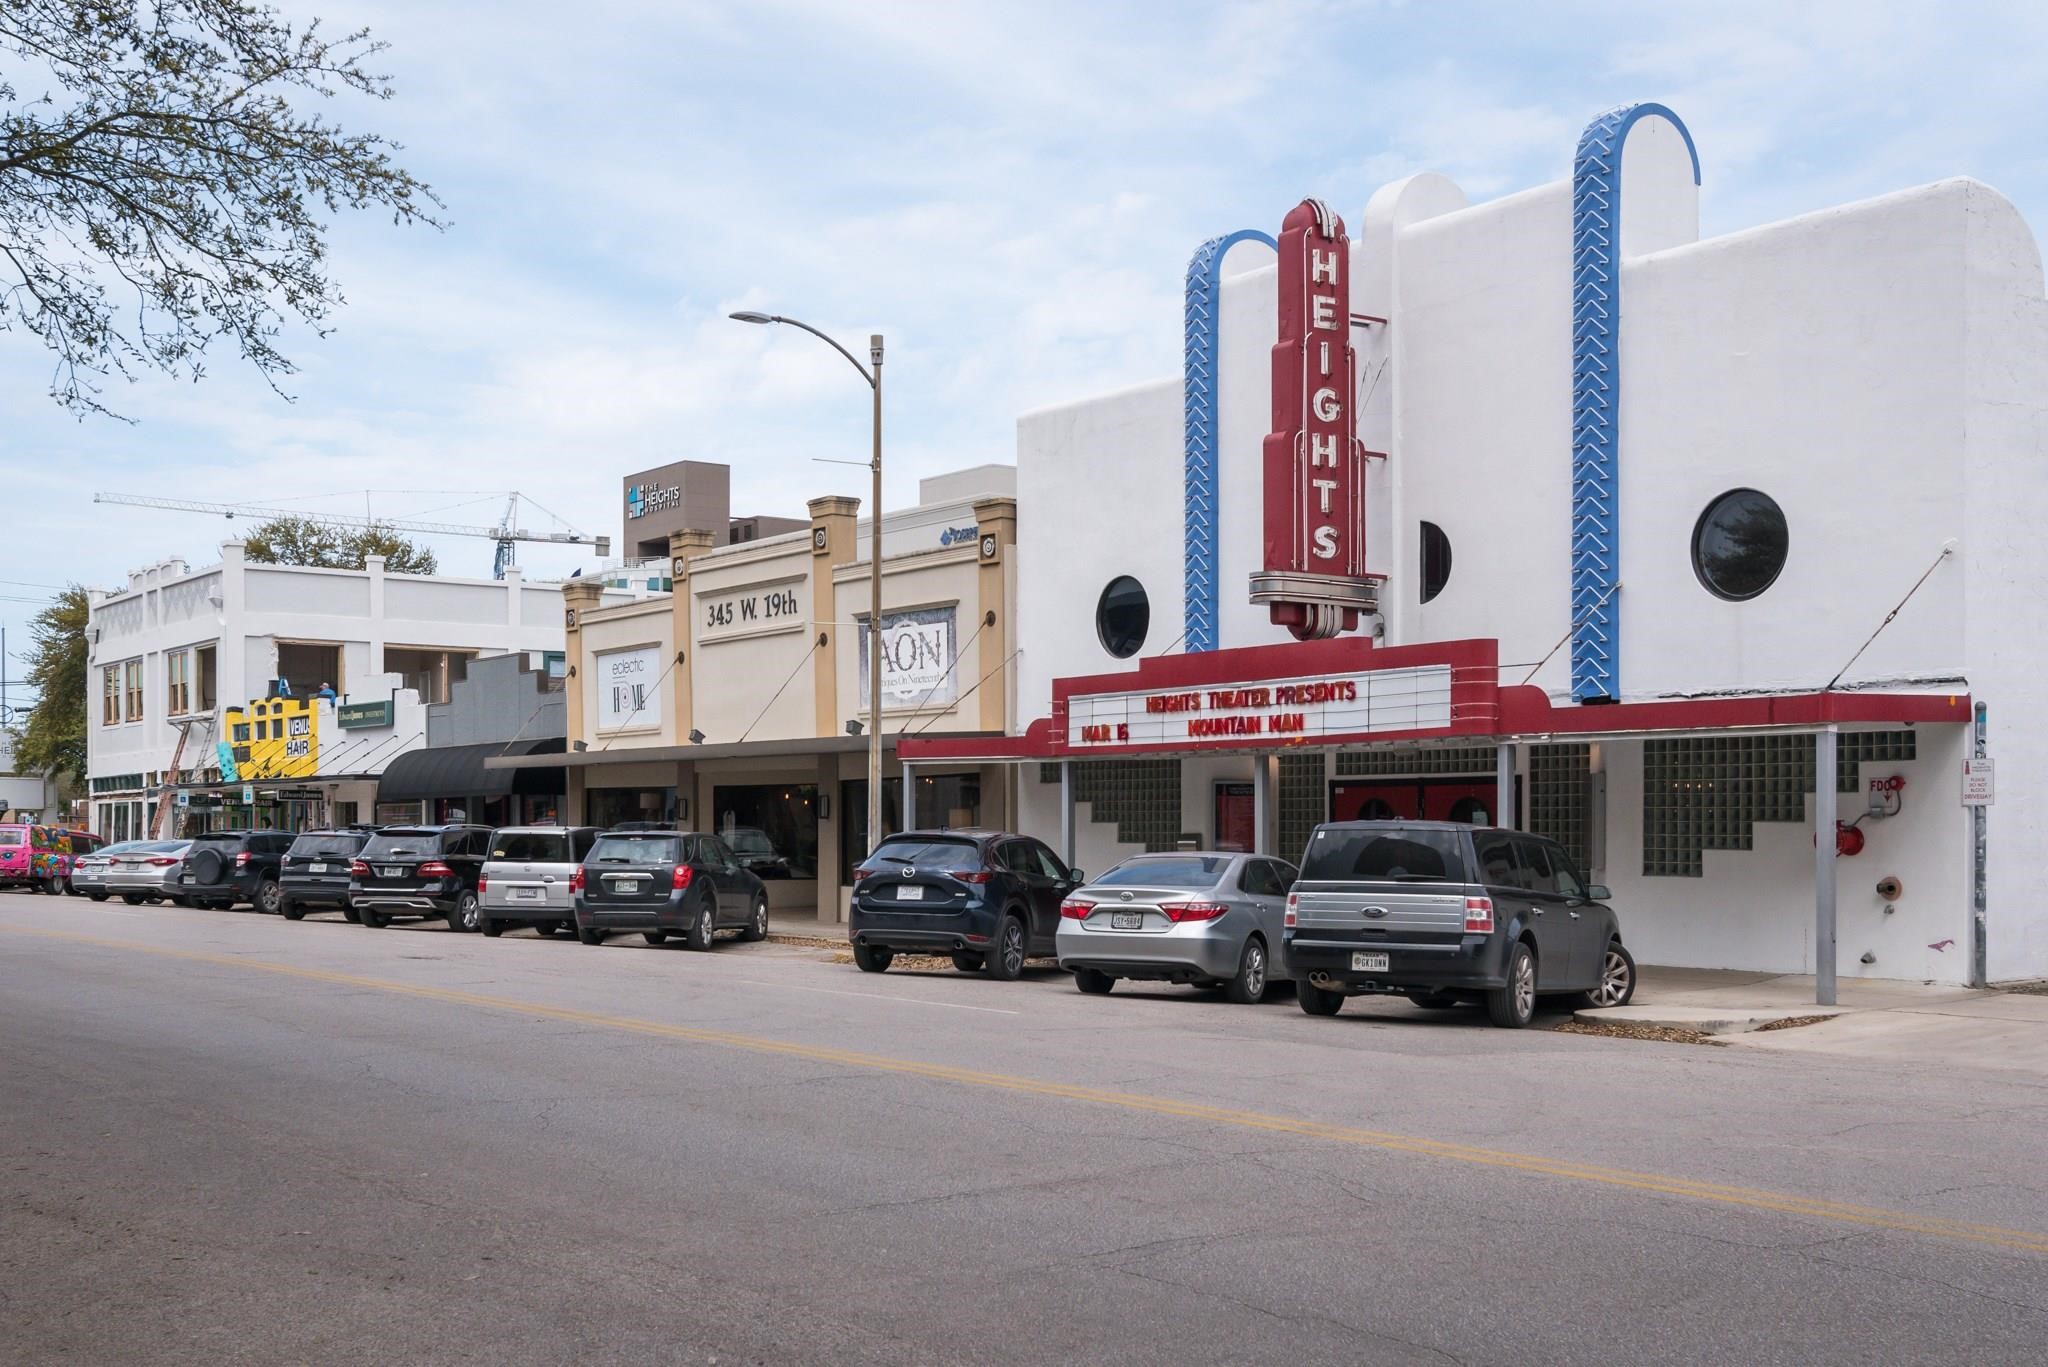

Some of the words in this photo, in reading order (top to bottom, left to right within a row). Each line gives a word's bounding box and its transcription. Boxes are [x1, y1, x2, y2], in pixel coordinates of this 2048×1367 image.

[1311, 248, 1343, 559] HEIGHTS
[645, 482, 658, 492] THE
[645, 486, 680, 506] HEIGHTS
[645, 500, 680, 513] HOSPITAL
[707, 602, 733, 627] 345
[740, 597, 758, 621] W.
[764, 589, 798, 618] 19th
[612, 657, 645, 675] eclectic
[1146, 692, 1200, 713] HEIGHTS
[1208, 688, 1270, 710] THEATER
[1276, 681, 1356, 705] PRESENTS
[1082, 724, 1111, 742] MAR
[1188, 716, 1260, 738] MOUNTAIN
[1269, 713, 1304, 732] MAN
[286, 740, 310, 757] HAIR
